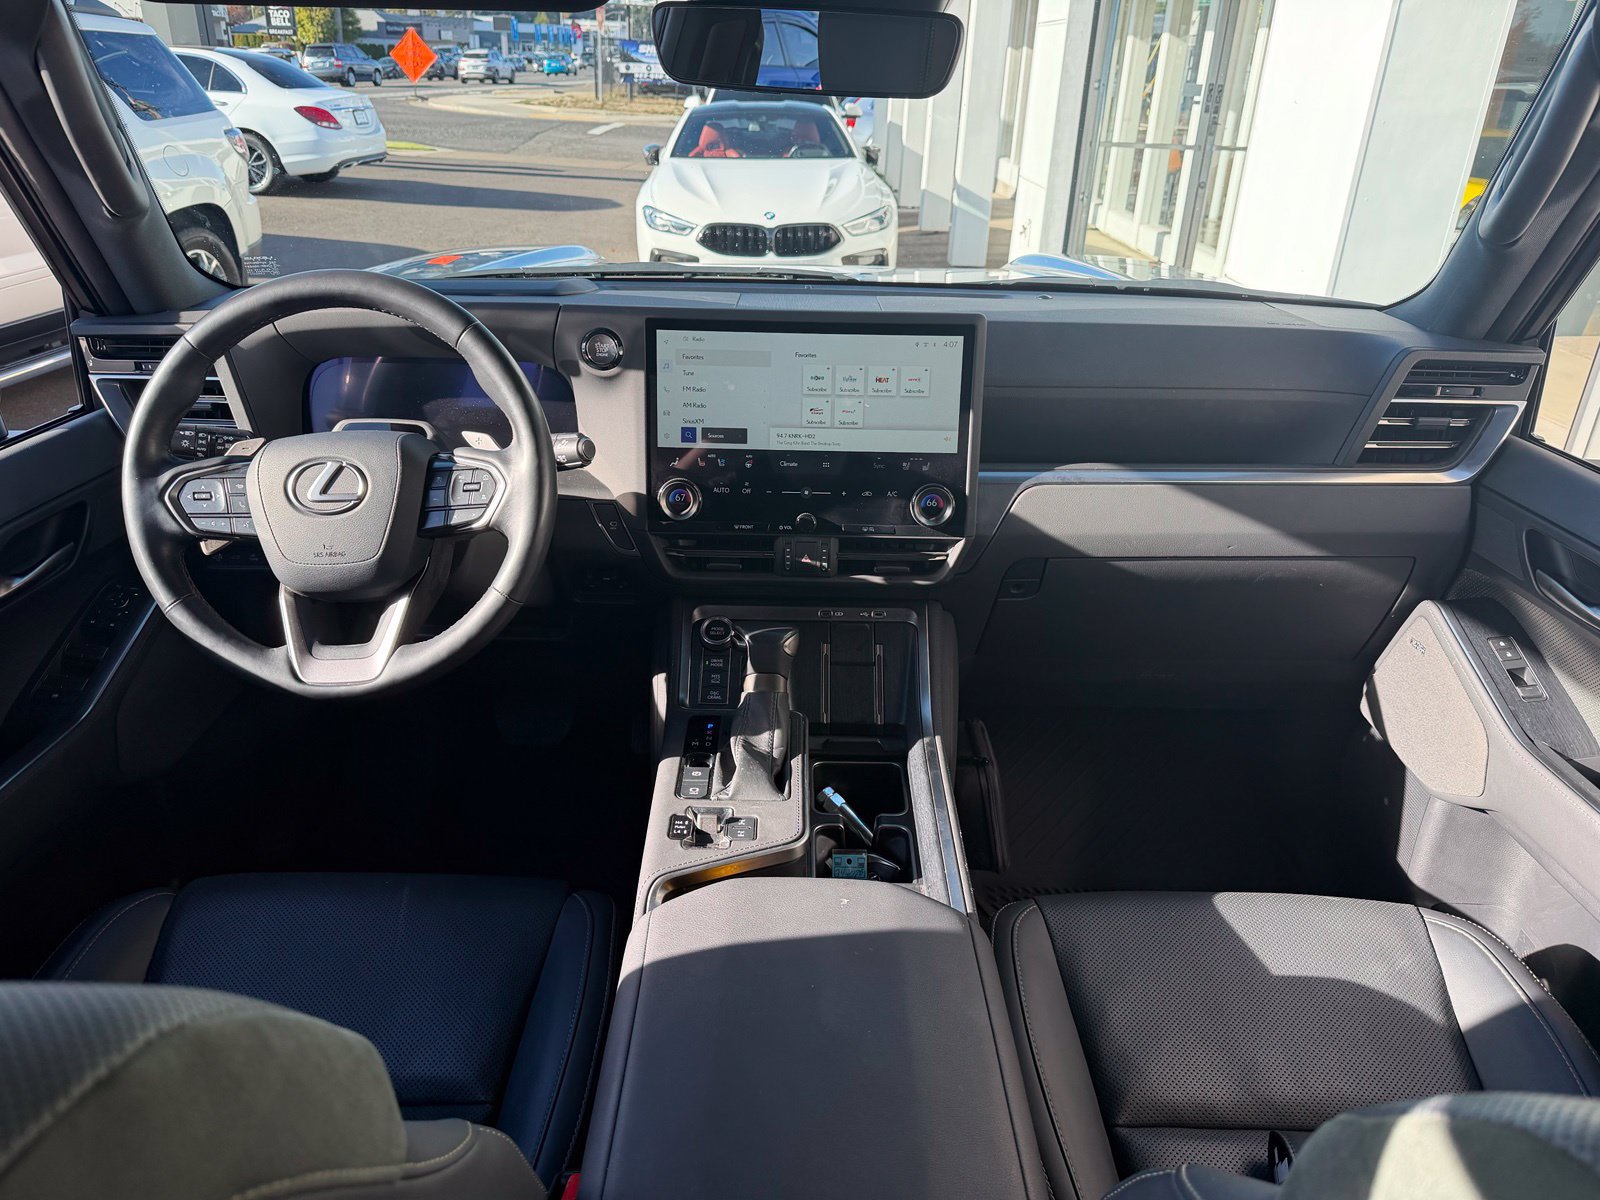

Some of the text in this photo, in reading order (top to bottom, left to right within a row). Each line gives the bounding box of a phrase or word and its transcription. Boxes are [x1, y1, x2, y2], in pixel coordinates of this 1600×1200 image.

[268, 9, 290, 18] TACO
[271, 17, 291, 26] BELL
[675, 493, 686, 502] 67
[926, 499, 938, 507] 66
